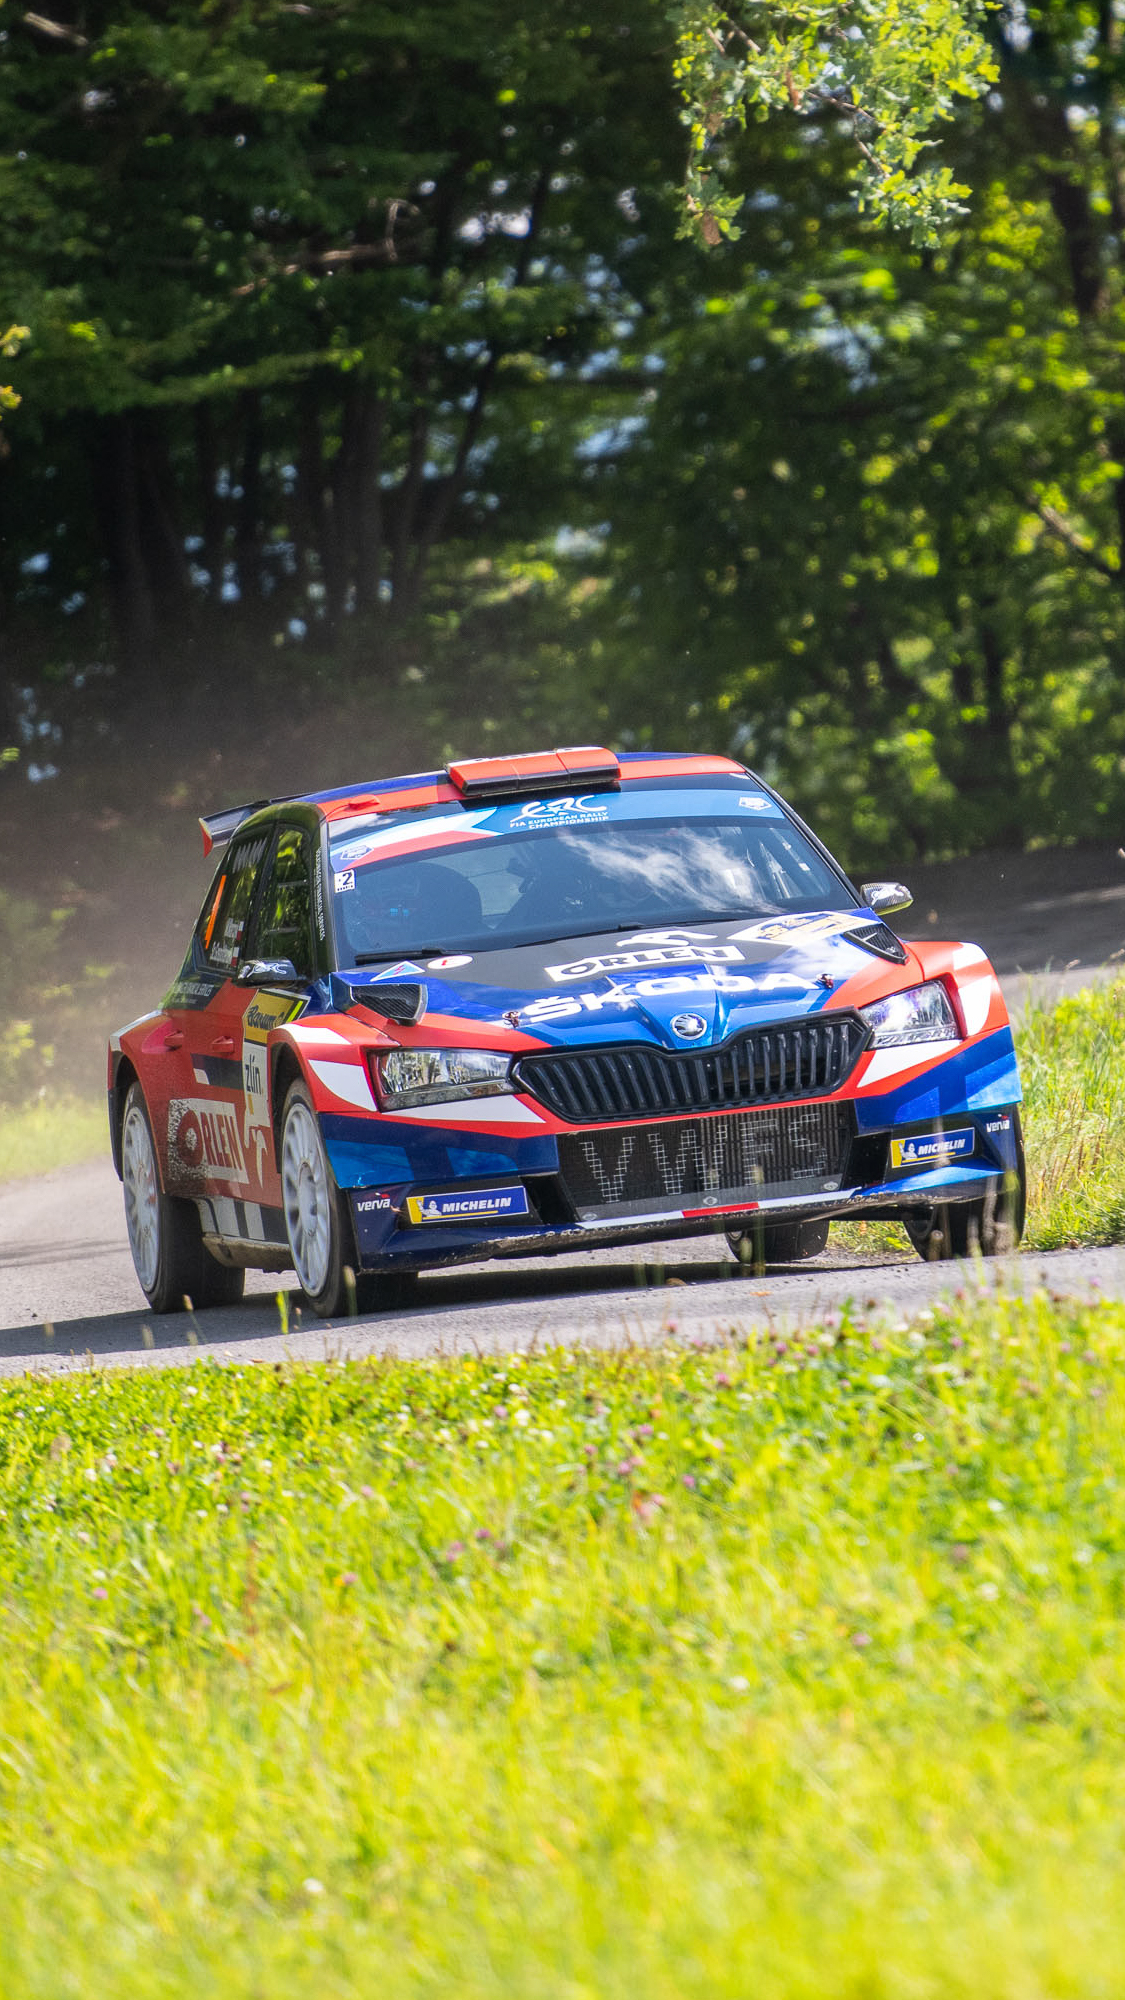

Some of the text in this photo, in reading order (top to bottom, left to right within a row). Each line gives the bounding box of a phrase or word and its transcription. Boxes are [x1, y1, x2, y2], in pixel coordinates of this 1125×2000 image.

[510, 795, 607, 822] ERC
[510, 811, 608, 828] FIA EUROPEAN RALLY
[528, 816, 609, 829] CHAMPIONSHIP
[561, 948, 729, 975] ORLEN
[524, 972, 820, 1024] ŠKODA
[245, 1053, 262, 1095] zlín
[986, 1120, 1010, 1132] verva
[176, 1108, 243, 1171] ORLEN
[917, 1139, 966, 1155] MICHELIN
[356, 1198, 391, 1212] verva
[442, 1197, 512, 1213] MICHELIN
